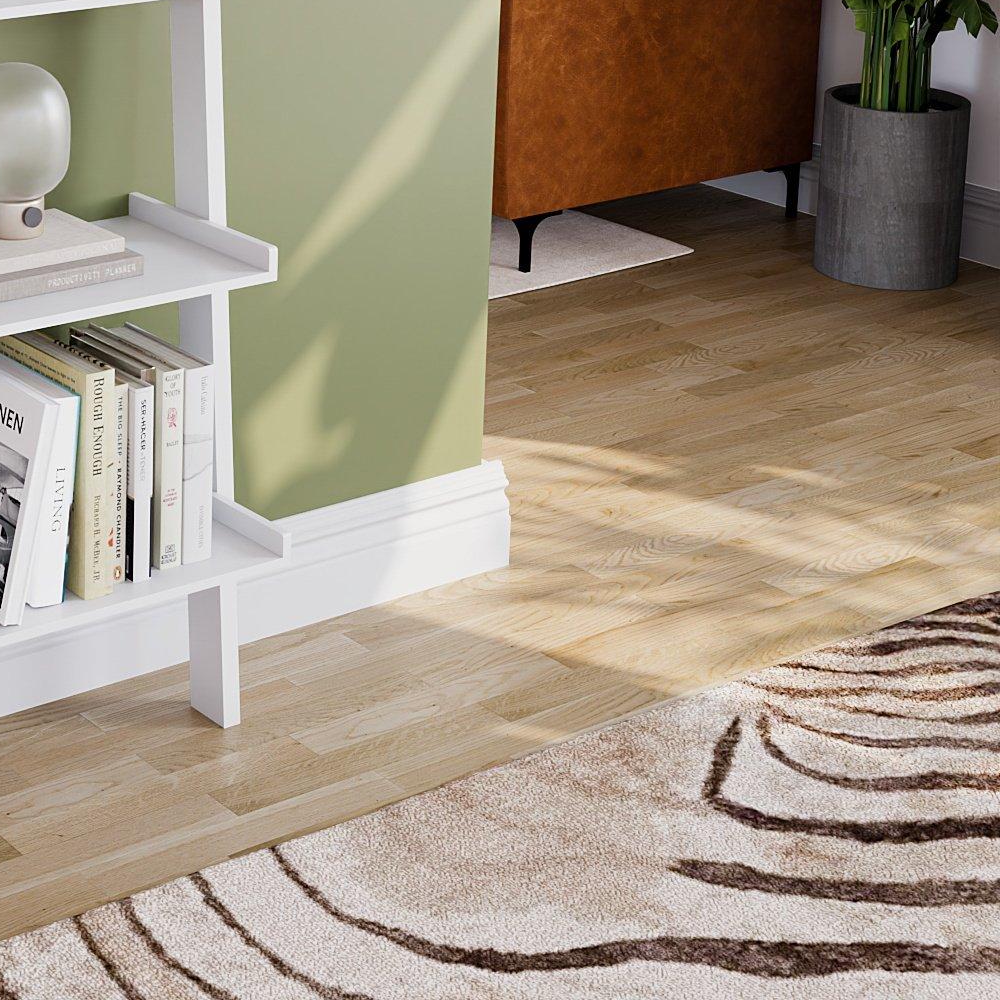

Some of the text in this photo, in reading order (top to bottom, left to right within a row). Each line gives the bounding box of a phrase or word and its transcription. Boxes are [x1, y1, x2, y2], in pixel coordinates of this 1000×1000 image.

[93, 377, 105, 422] ROUGH
[92, 425, 104, 477] ENOUGH
[51, 467, 66, 533] LIVING
